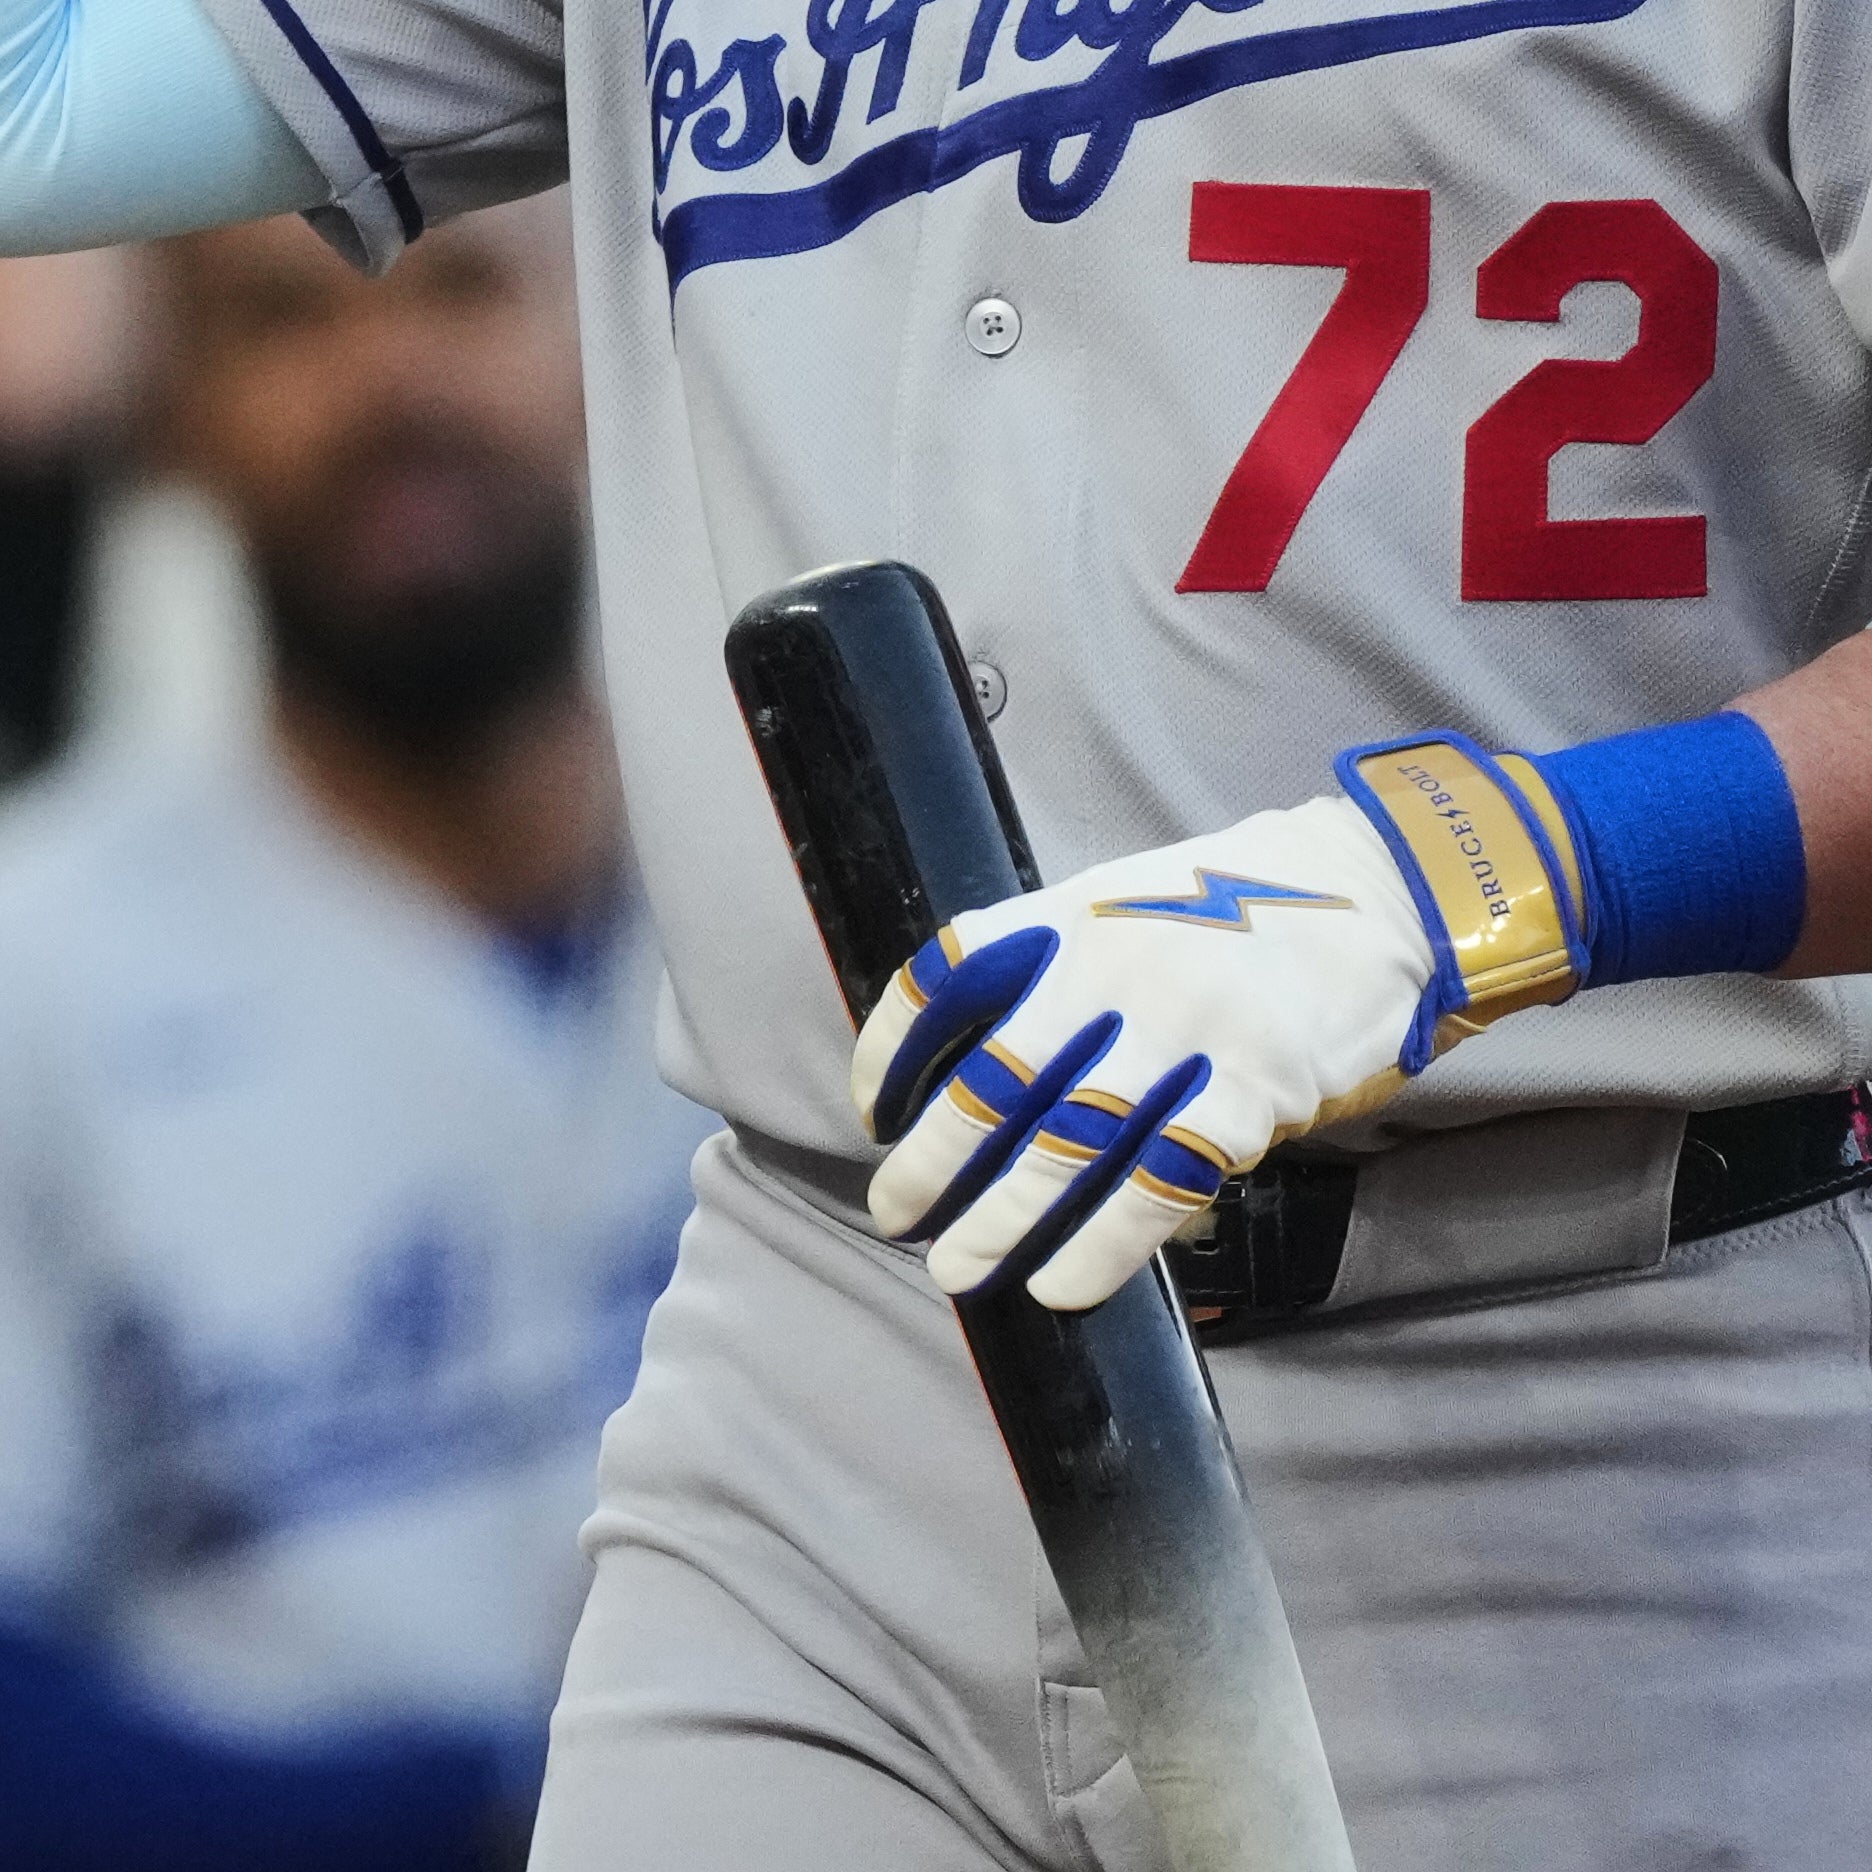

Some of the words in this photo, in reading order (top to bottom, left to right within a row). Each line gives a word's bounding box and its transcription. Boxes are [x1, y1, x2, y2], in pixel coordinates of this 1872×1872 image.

[1174, 180, 1720, 602] 72
[1396, 764, 1455, 808] BOLT
[1448, 819, 1512, 920] BRUCE
